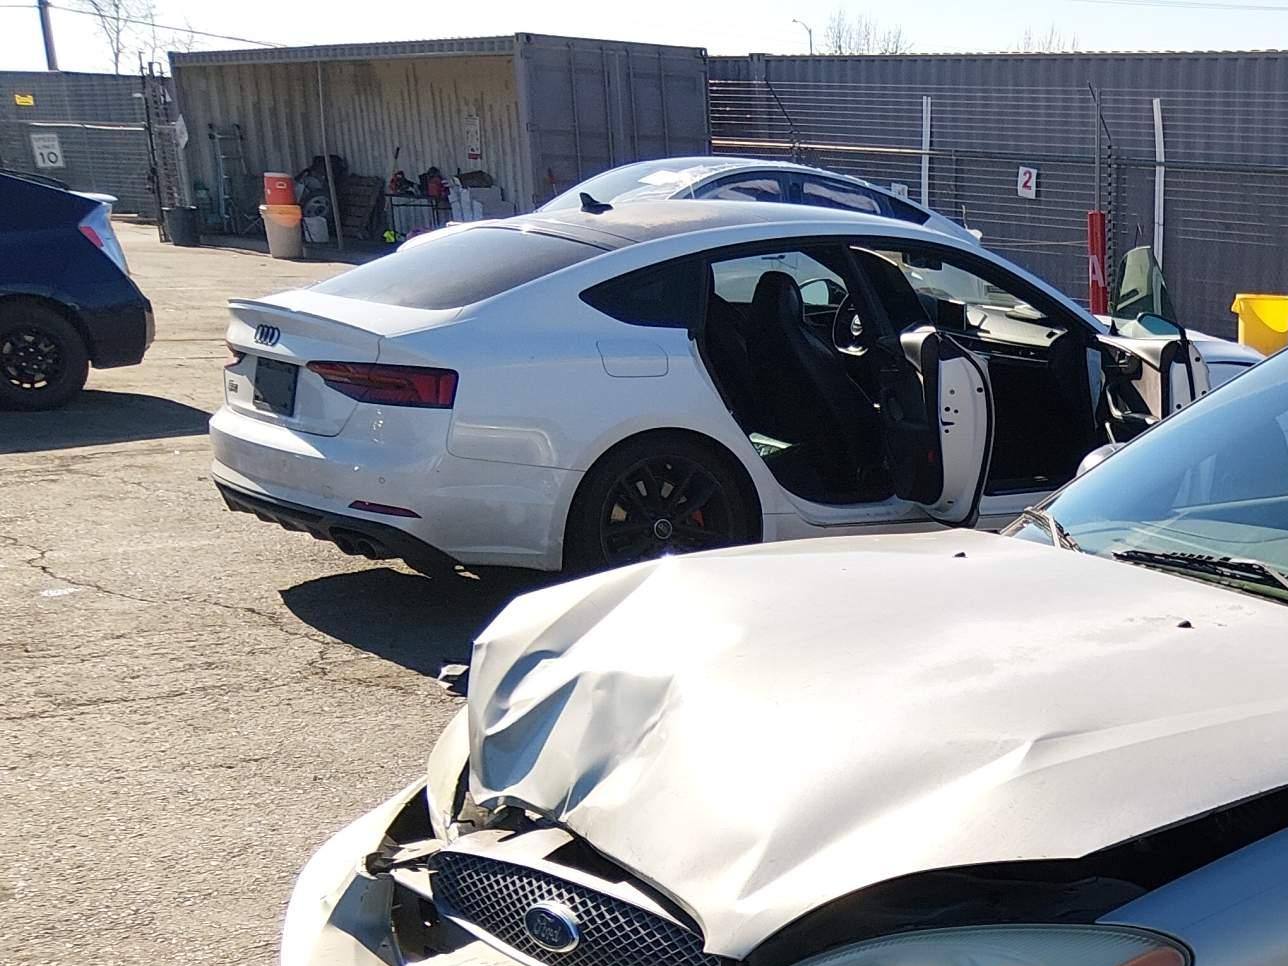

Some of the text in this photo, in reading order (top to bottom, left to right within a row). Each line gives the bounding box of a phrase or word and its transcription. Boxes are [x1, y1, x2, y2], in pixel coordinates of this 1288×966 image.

[39, 151, 59, 164] 10
[1021, 170, 1033, 190] 2
[1089, 254, 1106, 289] A
